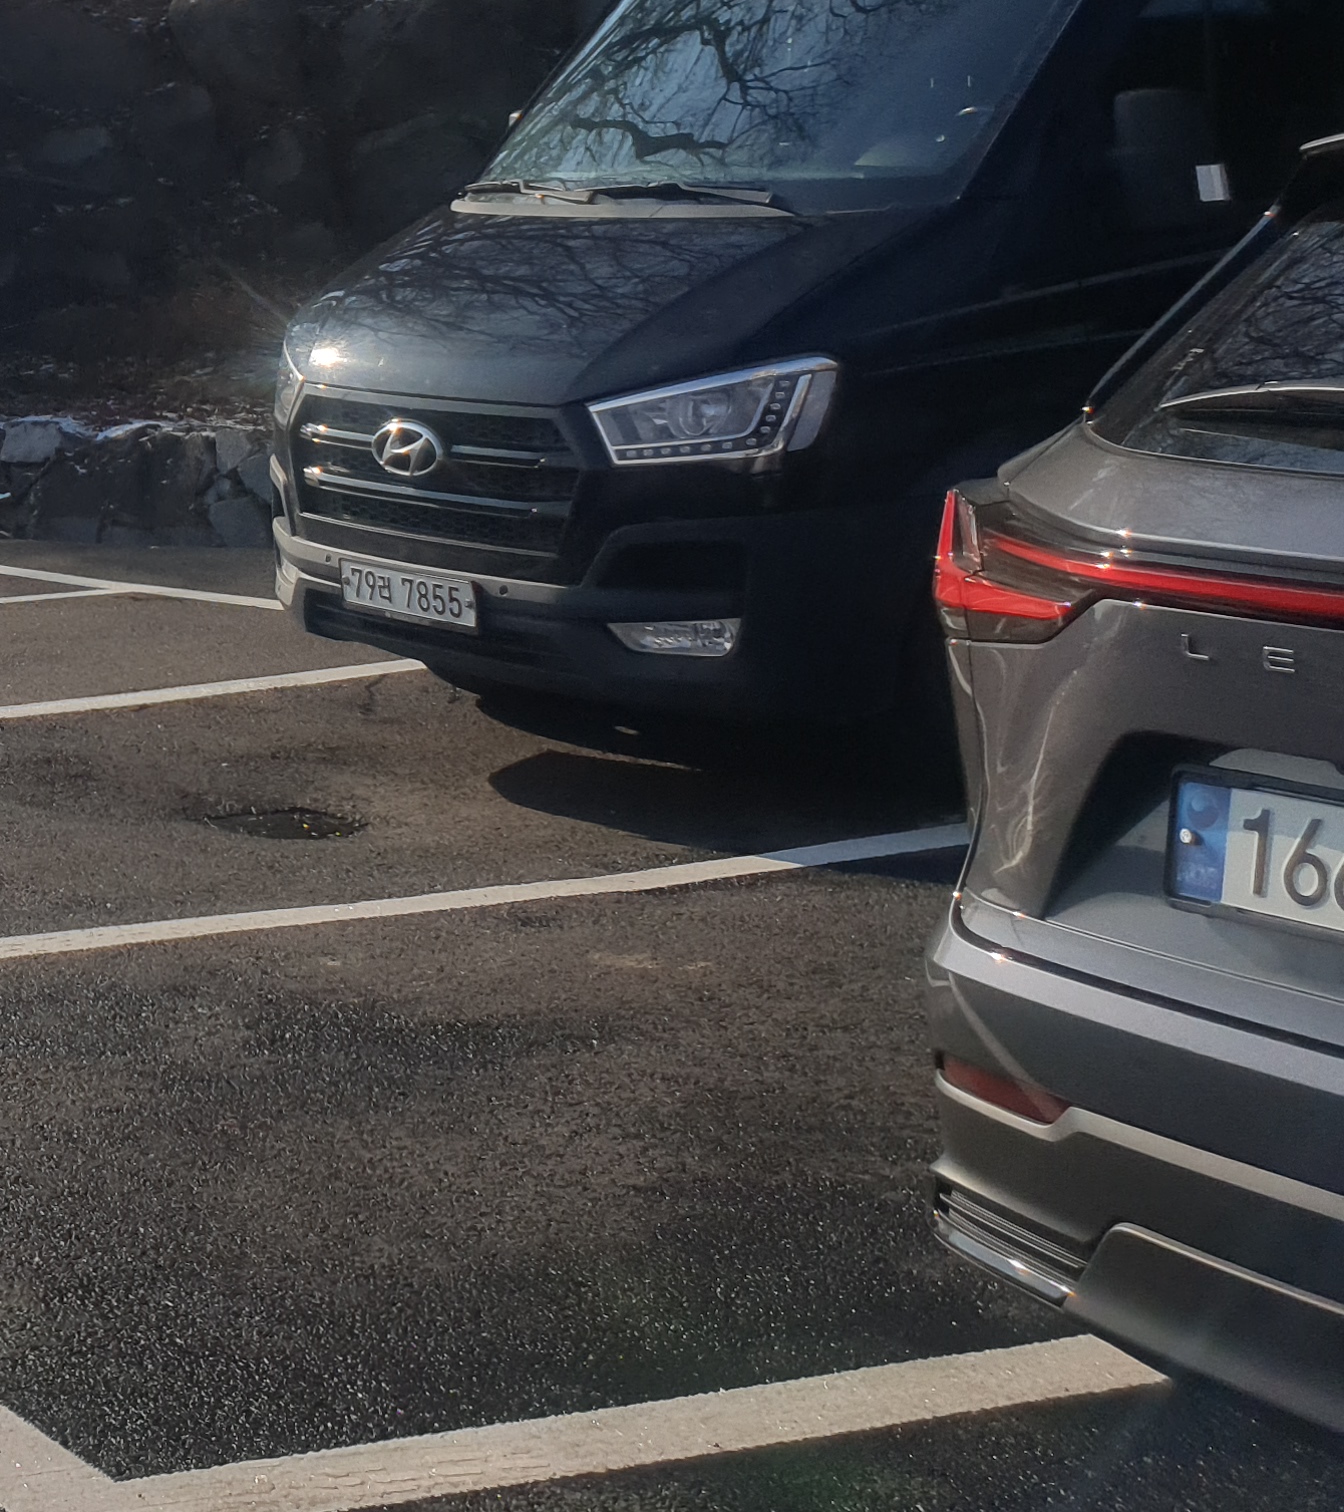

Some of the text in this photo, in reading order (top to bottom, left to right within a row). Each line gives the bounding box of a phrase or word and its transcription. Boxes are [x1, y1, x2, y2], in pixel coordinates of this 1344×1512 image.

[350, 567, 462, 619] 79러 7855
[1243, 808, 1344, 913] 16
